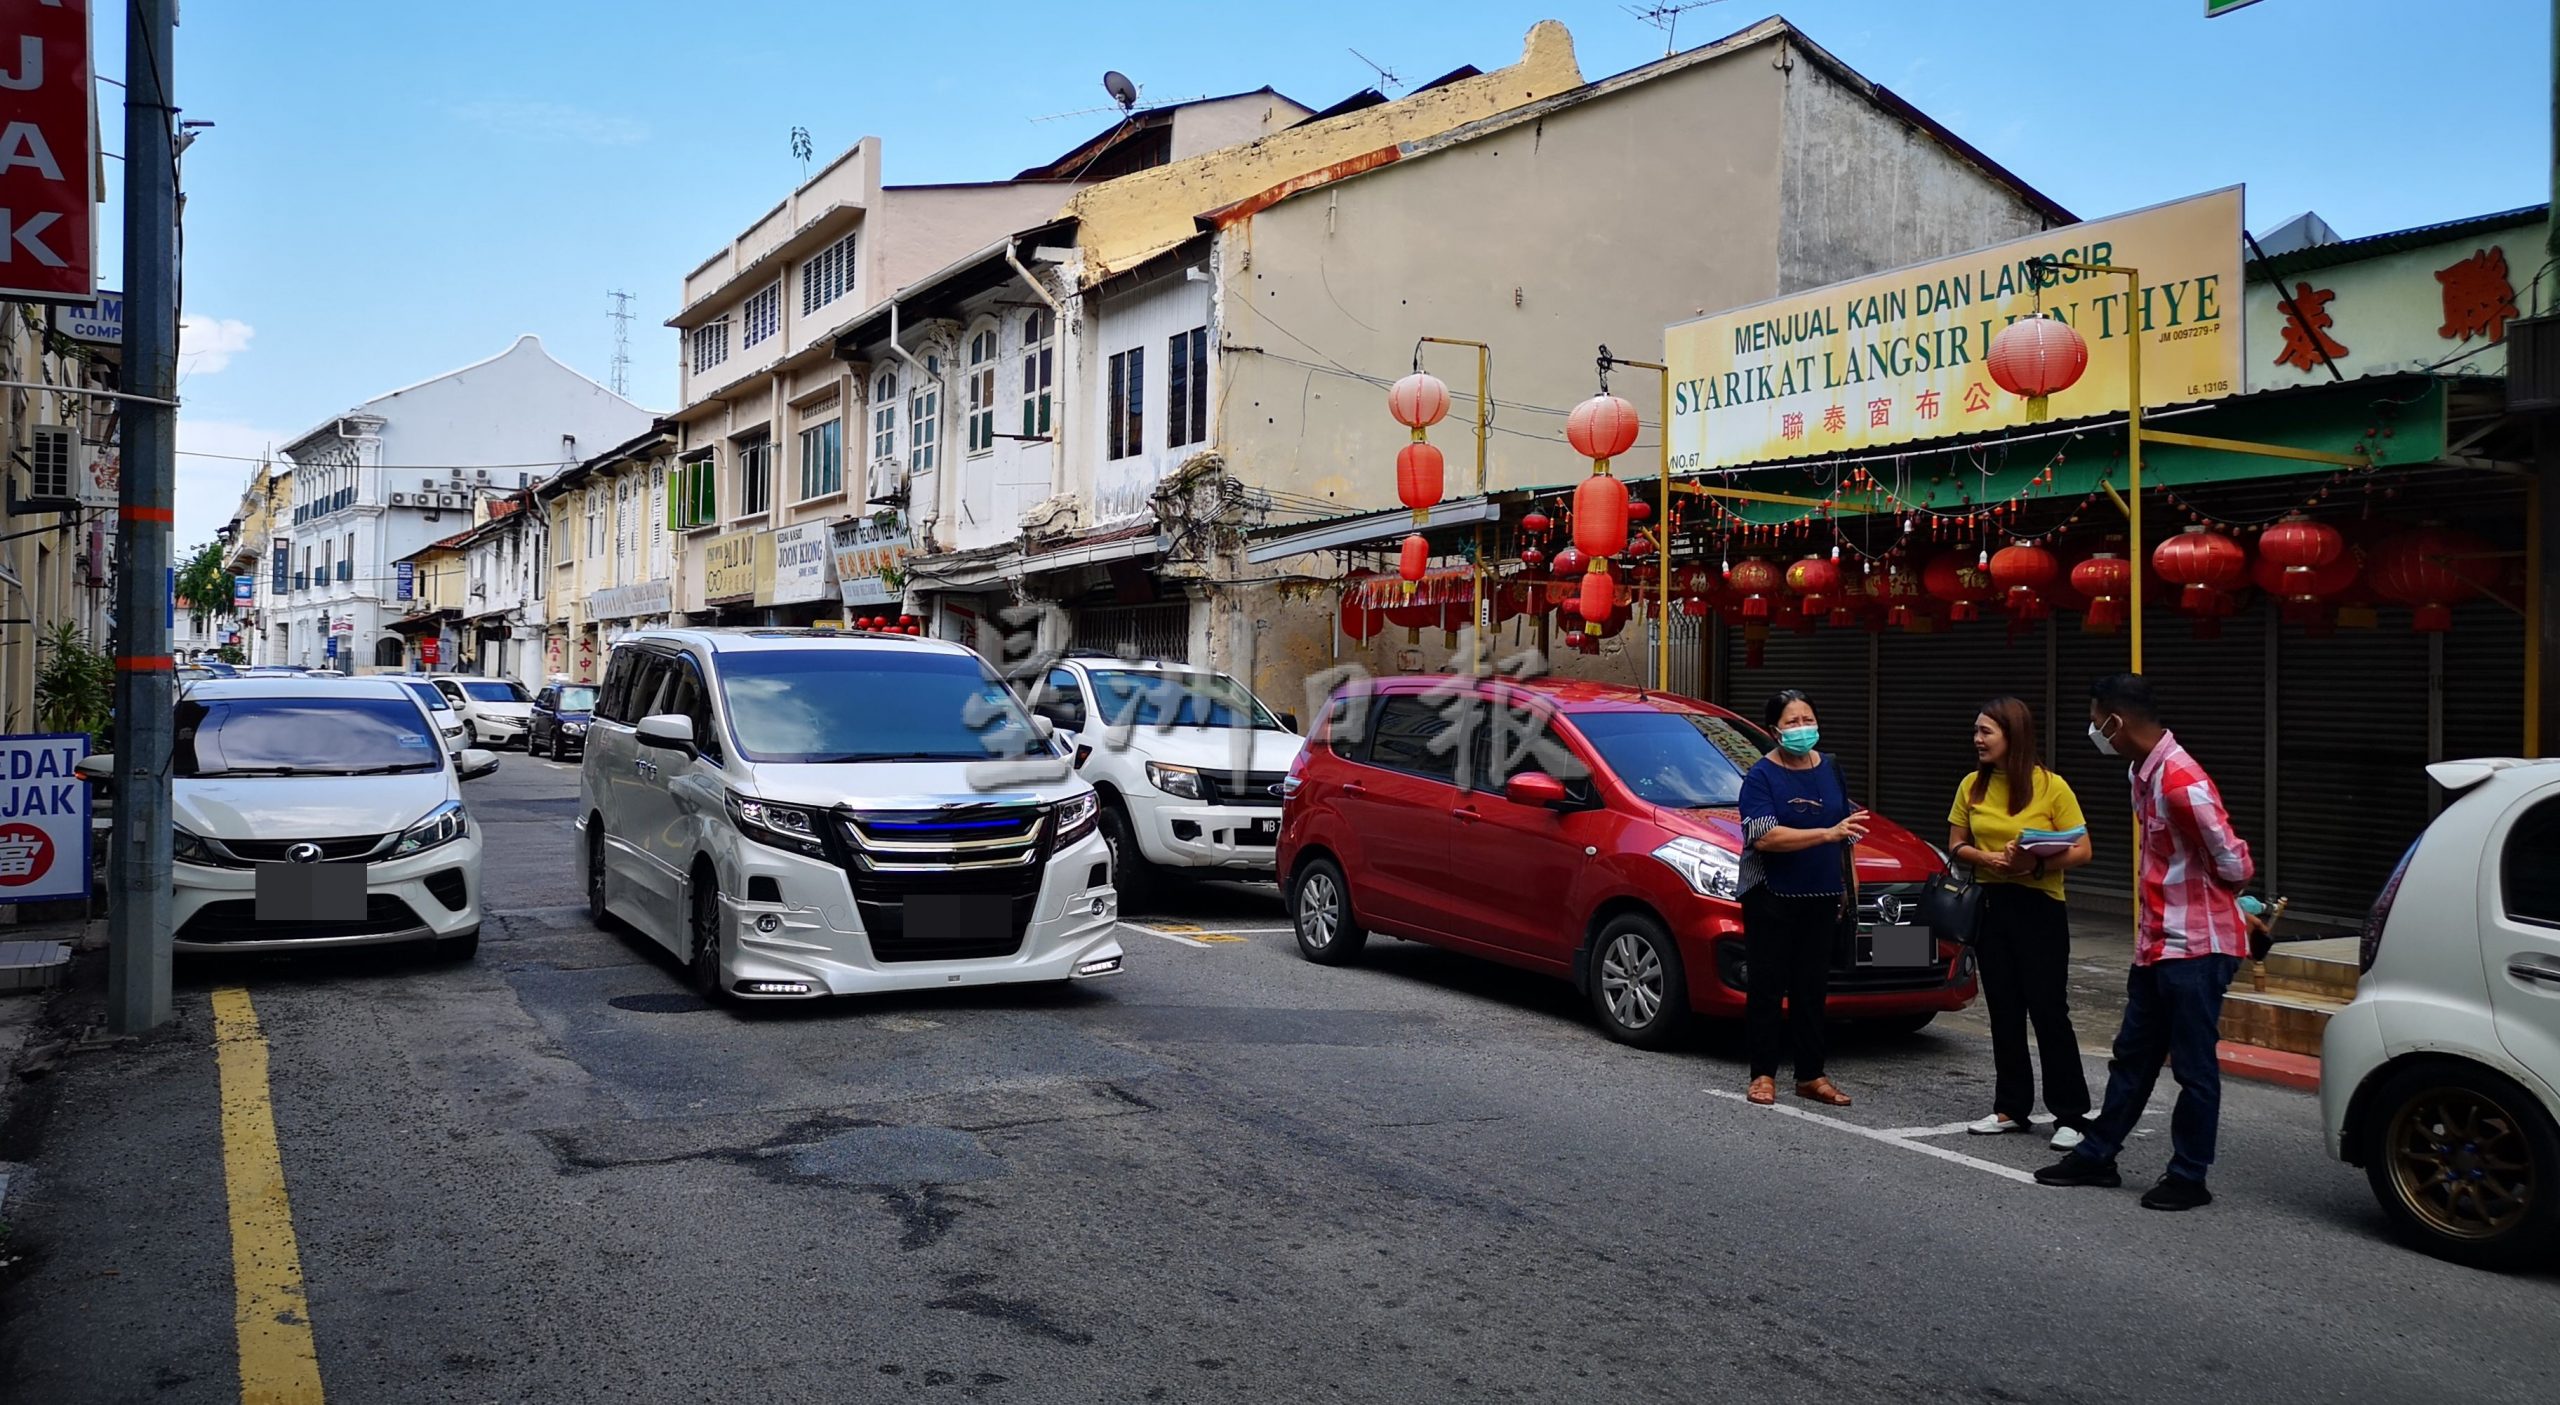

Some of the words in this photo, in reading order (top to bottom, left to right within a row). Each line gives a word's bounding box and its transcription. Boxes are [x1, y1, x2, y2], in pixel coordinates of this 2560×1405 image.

[1735, 306, 1839, 355] MENJUAL
[1848, 289, 1906, 331] KAIN
[1916, 274, 1971, 316] DAN
[1980, 241, 2113, 302] LANGSIR
[1675, 356, 1818, 416] SYARIKAT
[1823, 325, 1972, 389] LANGSIR
[2093, 274, 2221, 340] THYE
[2158, 331, 2171, 343] JM
[2203, 380, 2228, 394] 13105
[778, 544, 798, 569] JOON
